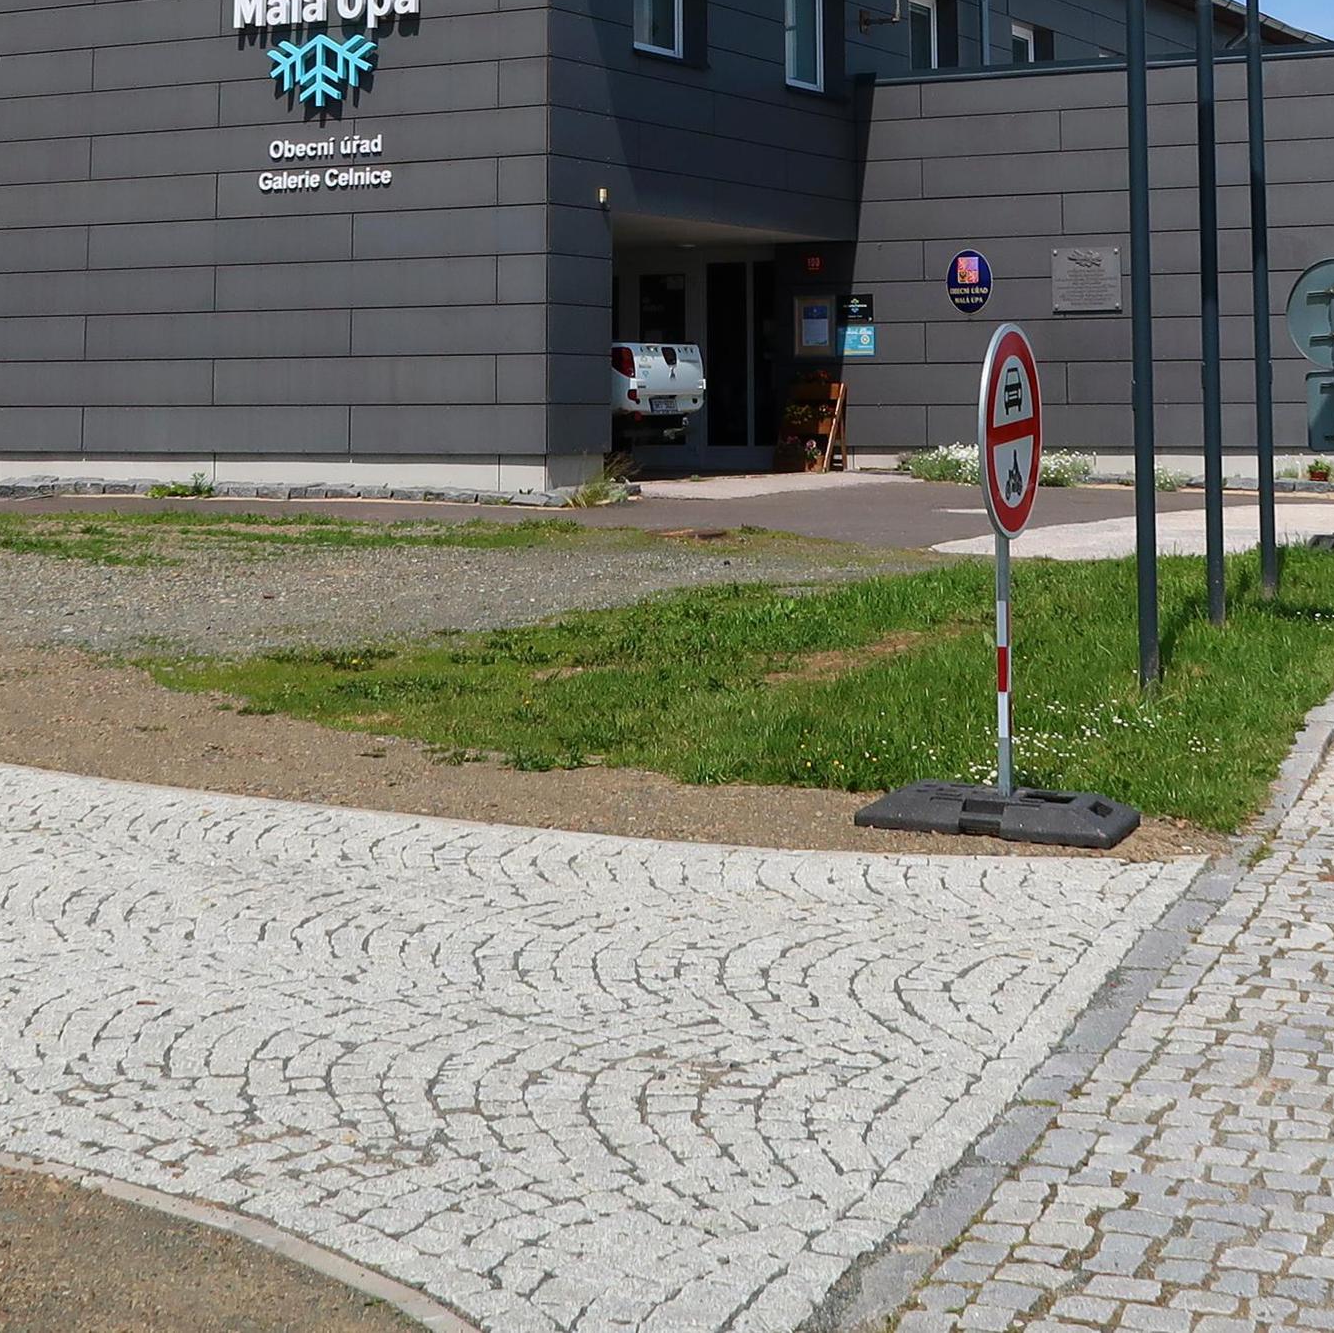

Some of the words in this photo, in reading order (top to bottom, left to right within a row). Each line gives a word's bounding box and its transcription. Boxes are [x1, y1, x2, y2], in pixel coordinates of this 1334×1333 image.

[269, 137, 335, 159] Obecní
[340, 134, 383, 155] úřad
[258, 171, 321, 191] Galerie
[324, 168, 392, 188] Celnice
